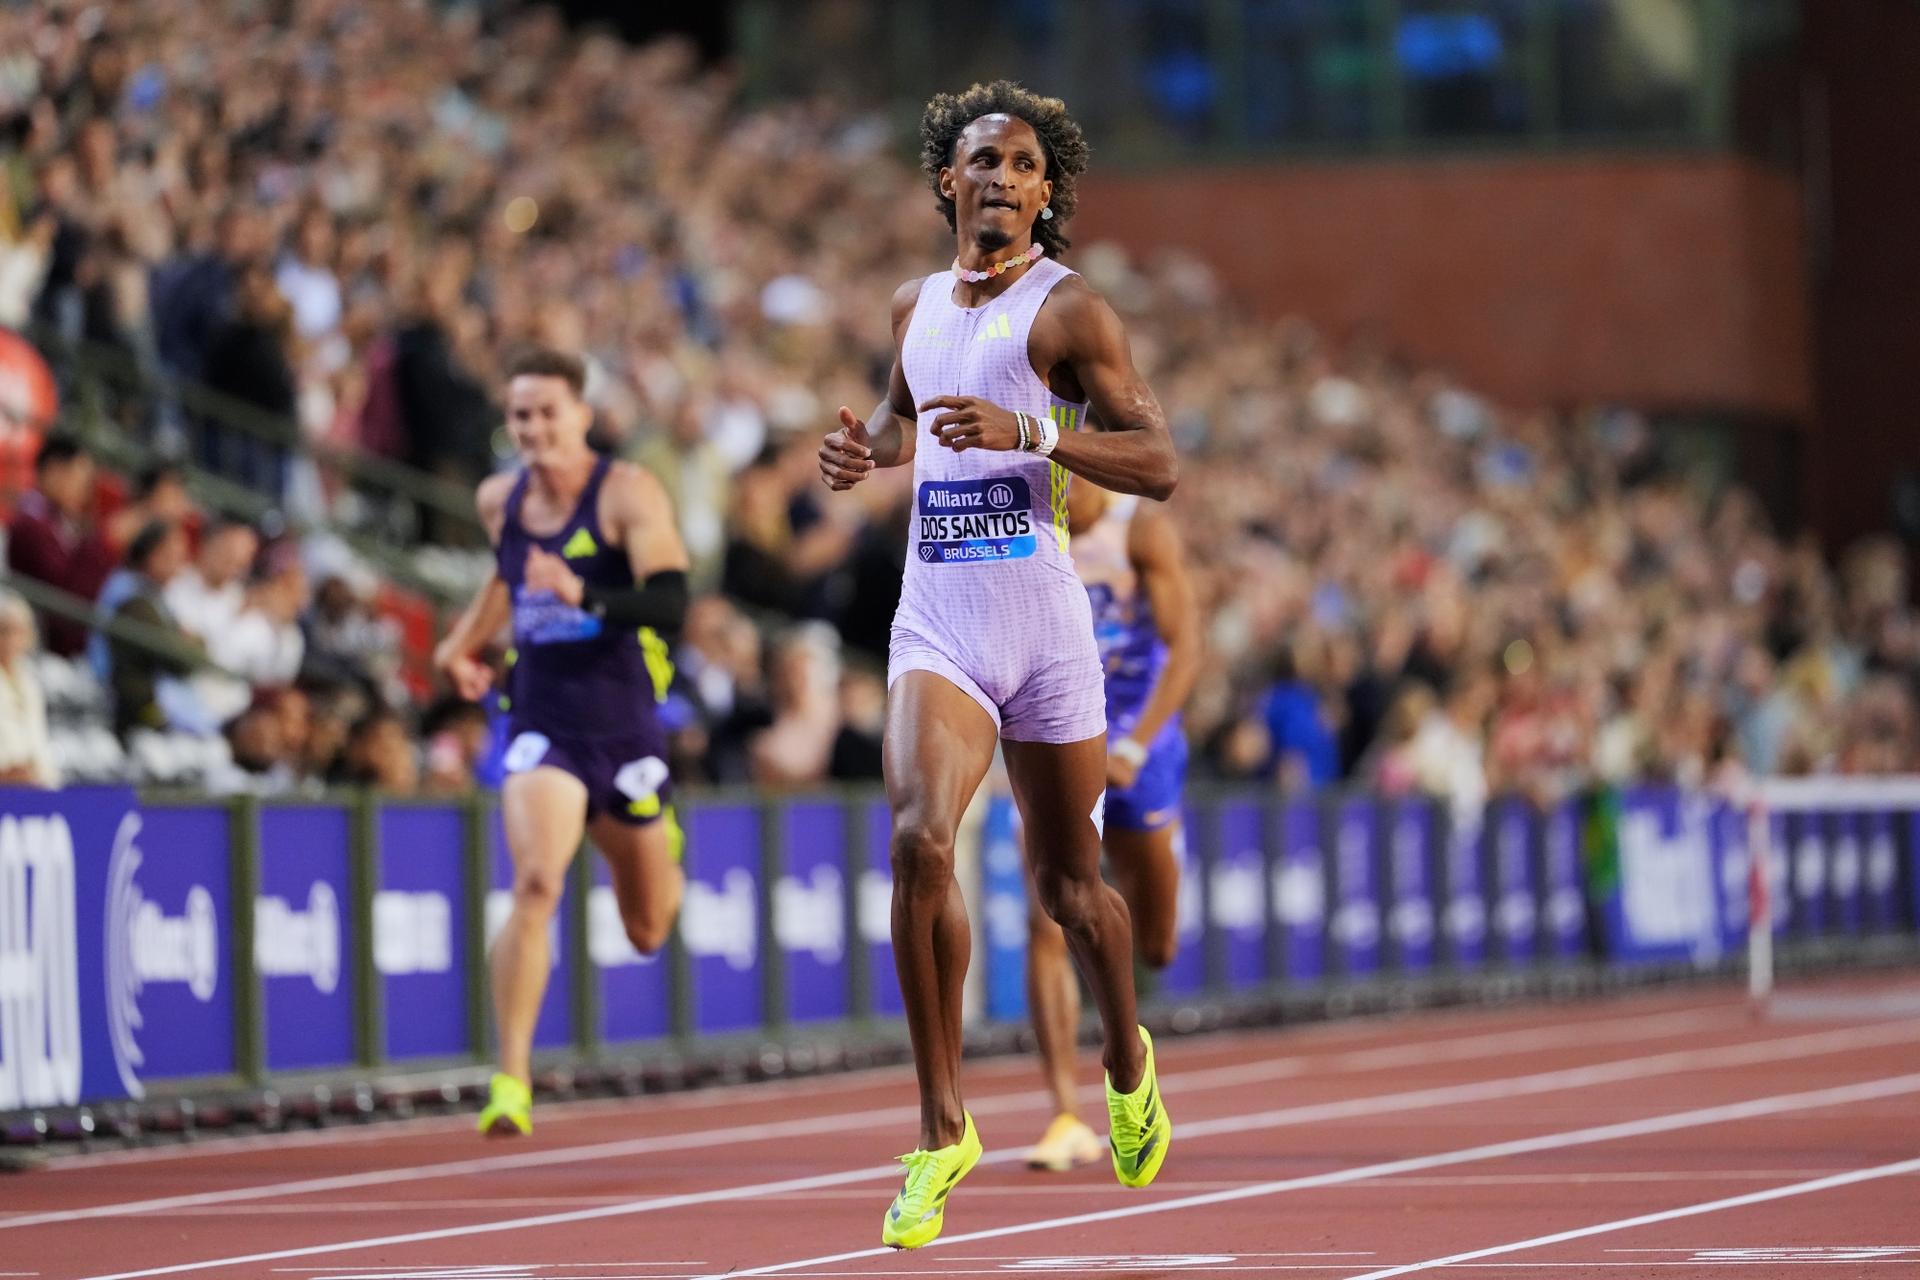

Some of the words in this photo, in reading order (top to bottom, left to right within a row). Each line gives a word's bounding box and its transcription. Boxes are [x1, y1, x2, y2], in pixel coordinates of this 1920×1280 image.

[927, 490, 984, 508] Allianz
[921, 516, 948, 540] DOS
[951, 511, 1030, 540] SANTOS
[944, 545, 1011, 560] BRUSSELS
